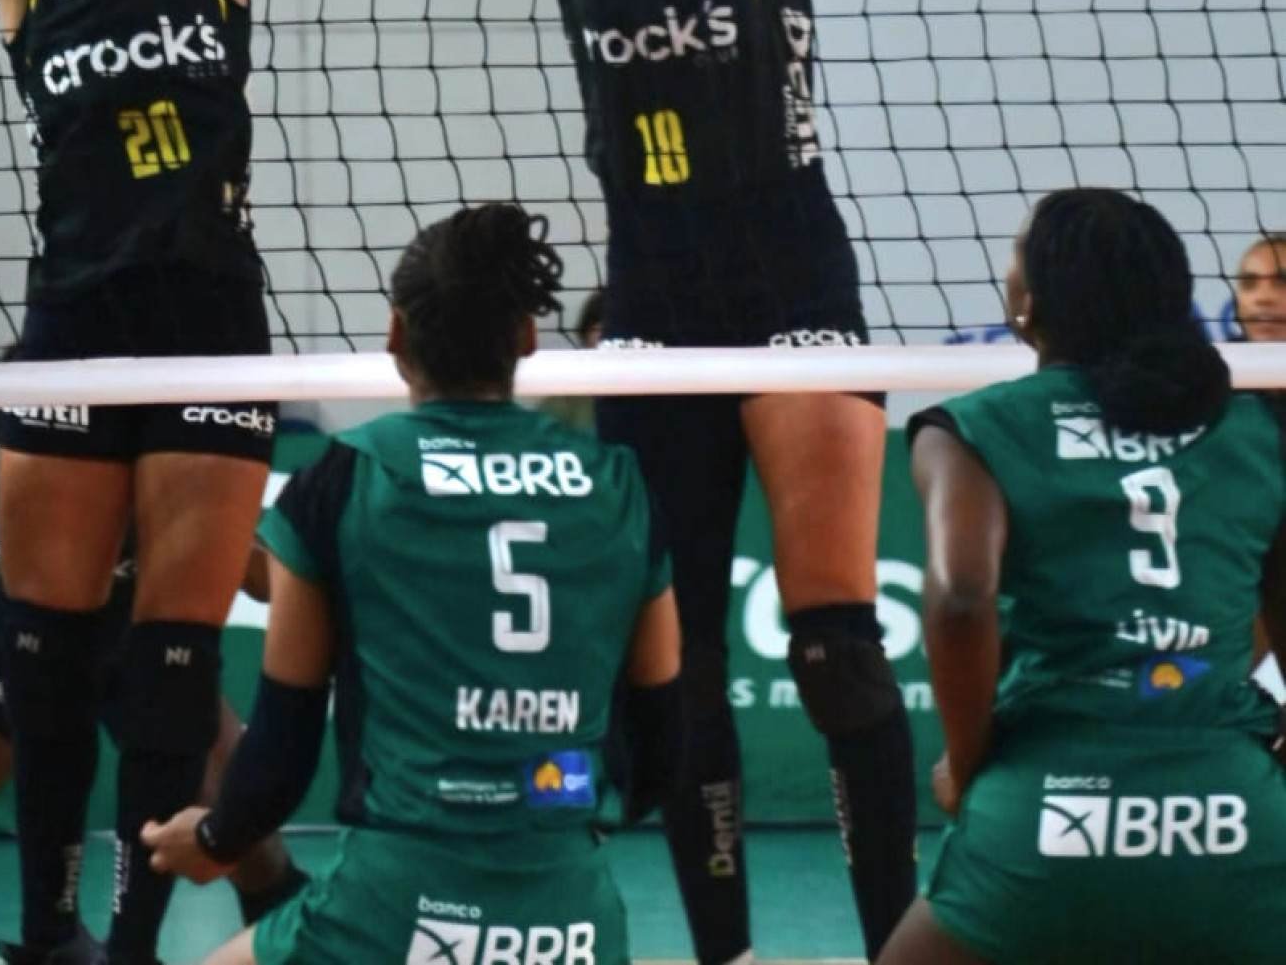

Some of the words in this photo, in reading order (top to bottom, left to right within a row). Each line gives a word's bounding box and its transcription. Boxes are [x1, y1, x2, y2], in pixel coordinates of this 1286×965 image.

[43, 13, 225, 94] crock's
[581, 0, 738, 64] rock's
[118, 99, 191, 179] 20
[483, 451, 593, 497] BRB
[1120, 466, 1181, 589] 9
[488, 520, 551, 653] 5
[456, 686, 580, 734] KAREN
[1043, 774, 1112, 790] banco
[1114, 794, 1248, 858] BRB
[417, 895, 482, 919] banco
[481, 921, 596, 965] BRB
